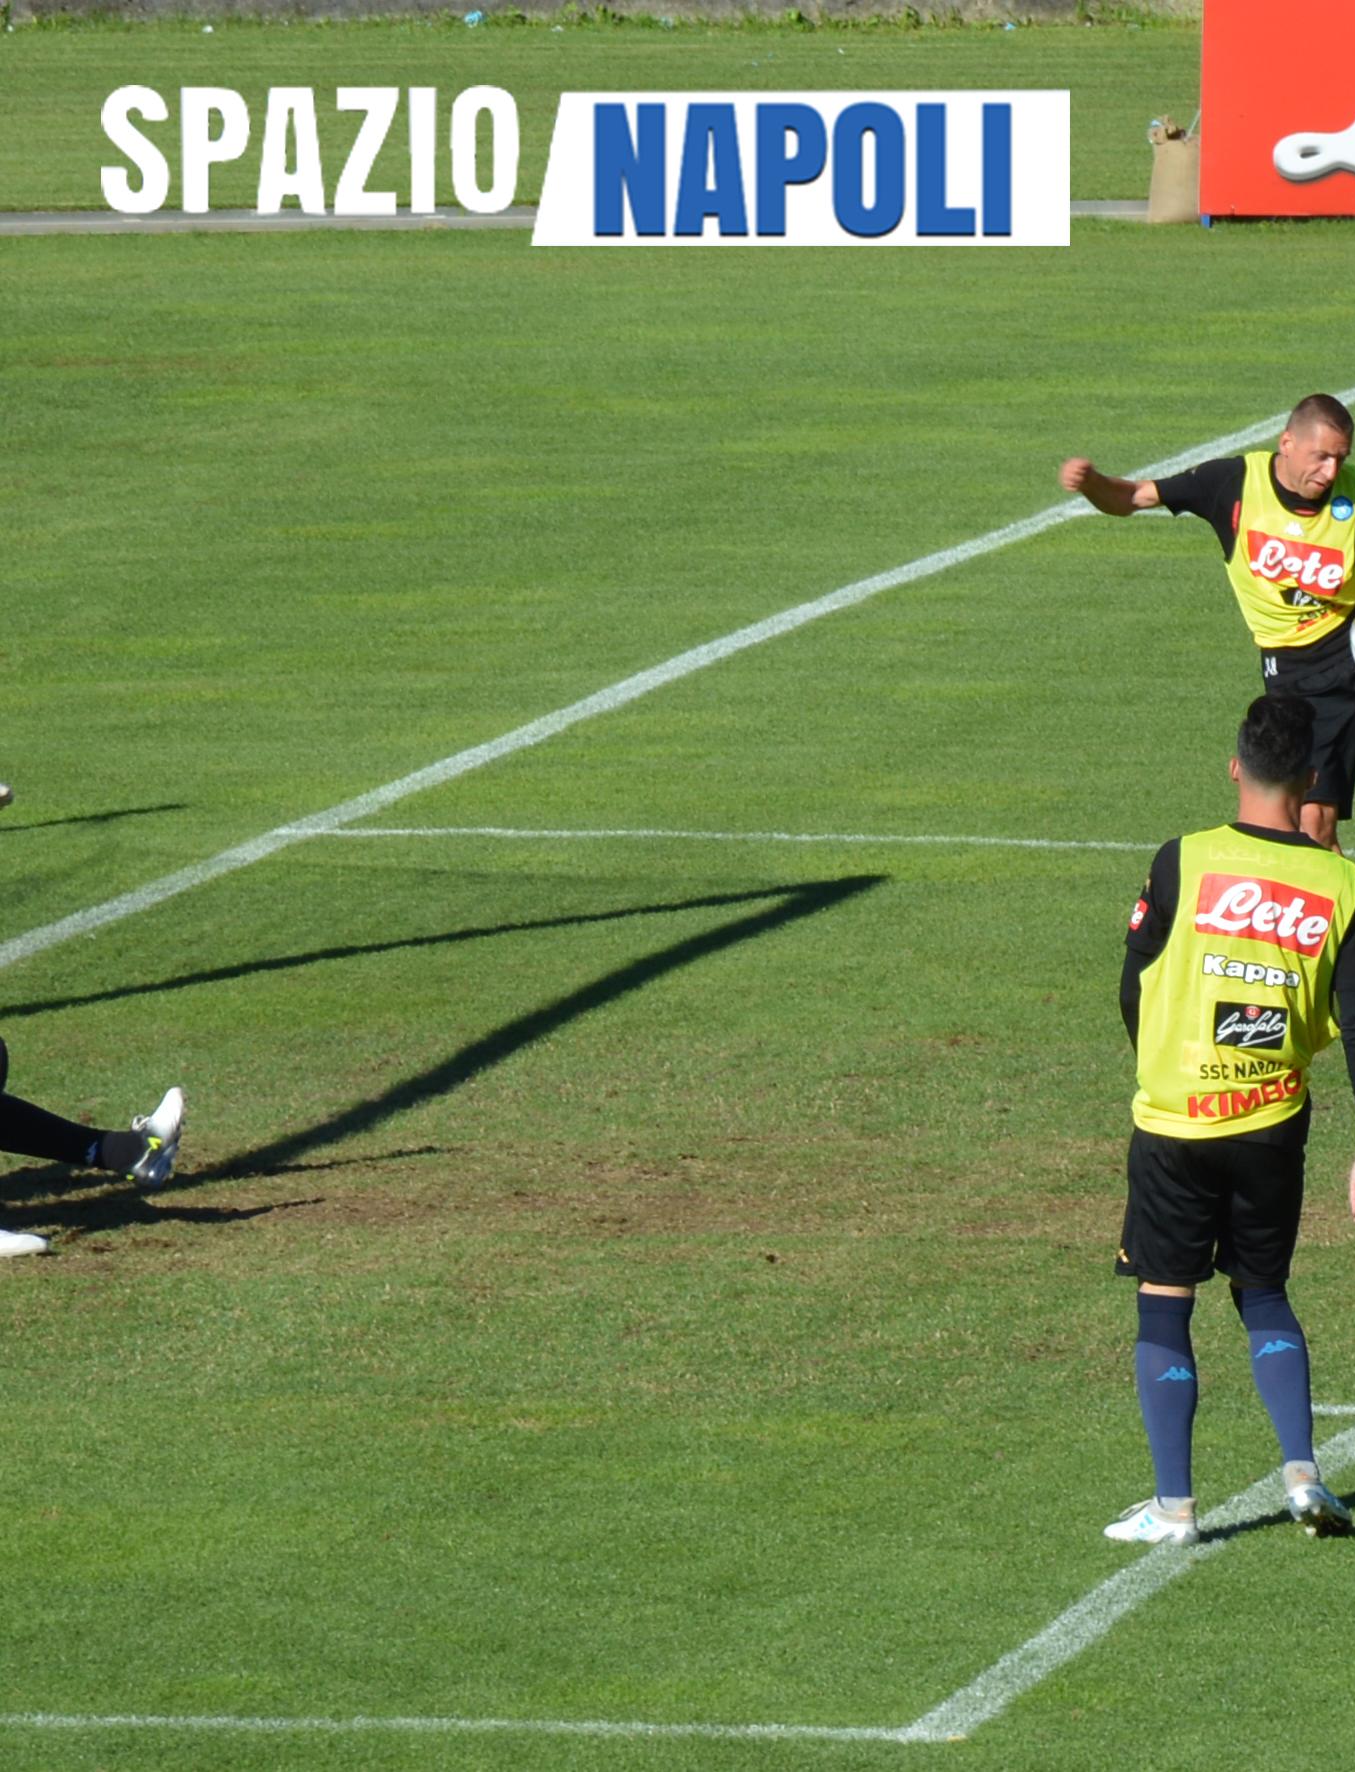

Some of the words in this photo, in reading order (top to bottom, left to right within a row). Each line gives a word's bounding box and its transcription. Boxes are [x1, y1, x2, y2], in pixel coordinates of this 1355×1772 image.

[1250, 539, 1344, 590] Lete
[1195, 881, 1329, 946] Lete
[1202, 953, 1300, 989] Kappa
[1187, 1069, 1302, 1118] KIMBO
[1199, 1063, 1230, 1080] SSC
